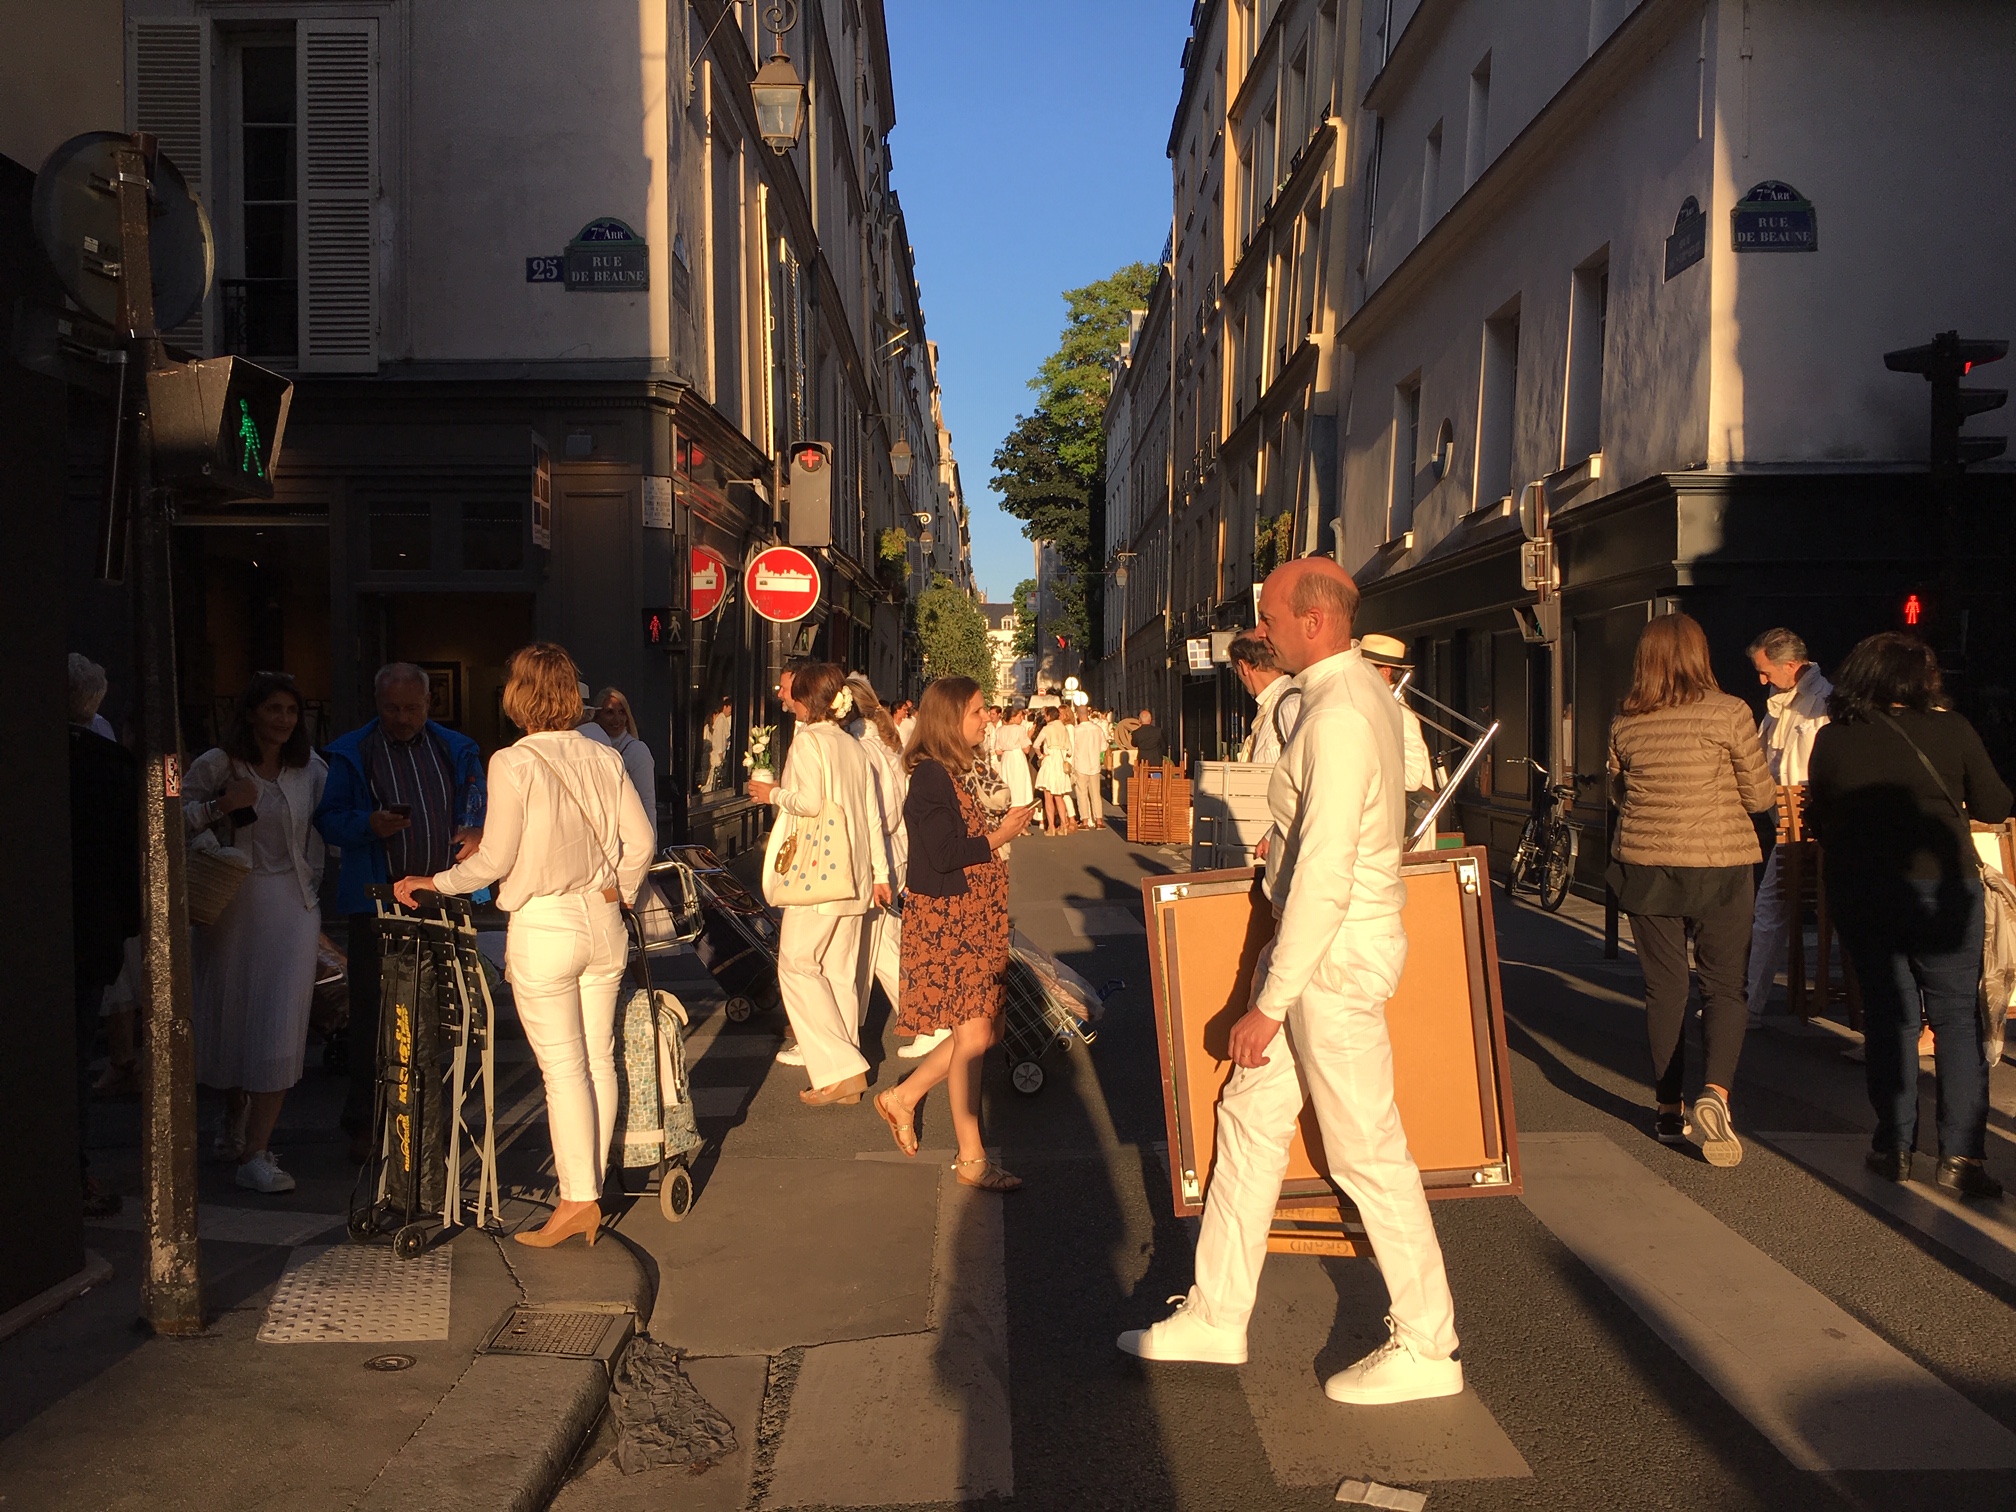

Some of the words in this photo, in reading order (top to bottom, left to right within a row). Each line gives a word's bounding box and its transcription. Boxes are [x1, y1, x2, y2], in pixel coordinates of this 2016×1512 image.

[1758, 217, 1788, 228] RUE
[1737, 233, 1755, 243] DE
[1760, 231, 1811, 243] BEAUNE
[592, 256, 622, 267] RUE
[532, 259, 558, 280] 25
[571, 271, 589, 282] DE
[594, 270, 644, 282] BEAUNE
[1290, 1241, 1349, 1254] GRAND
